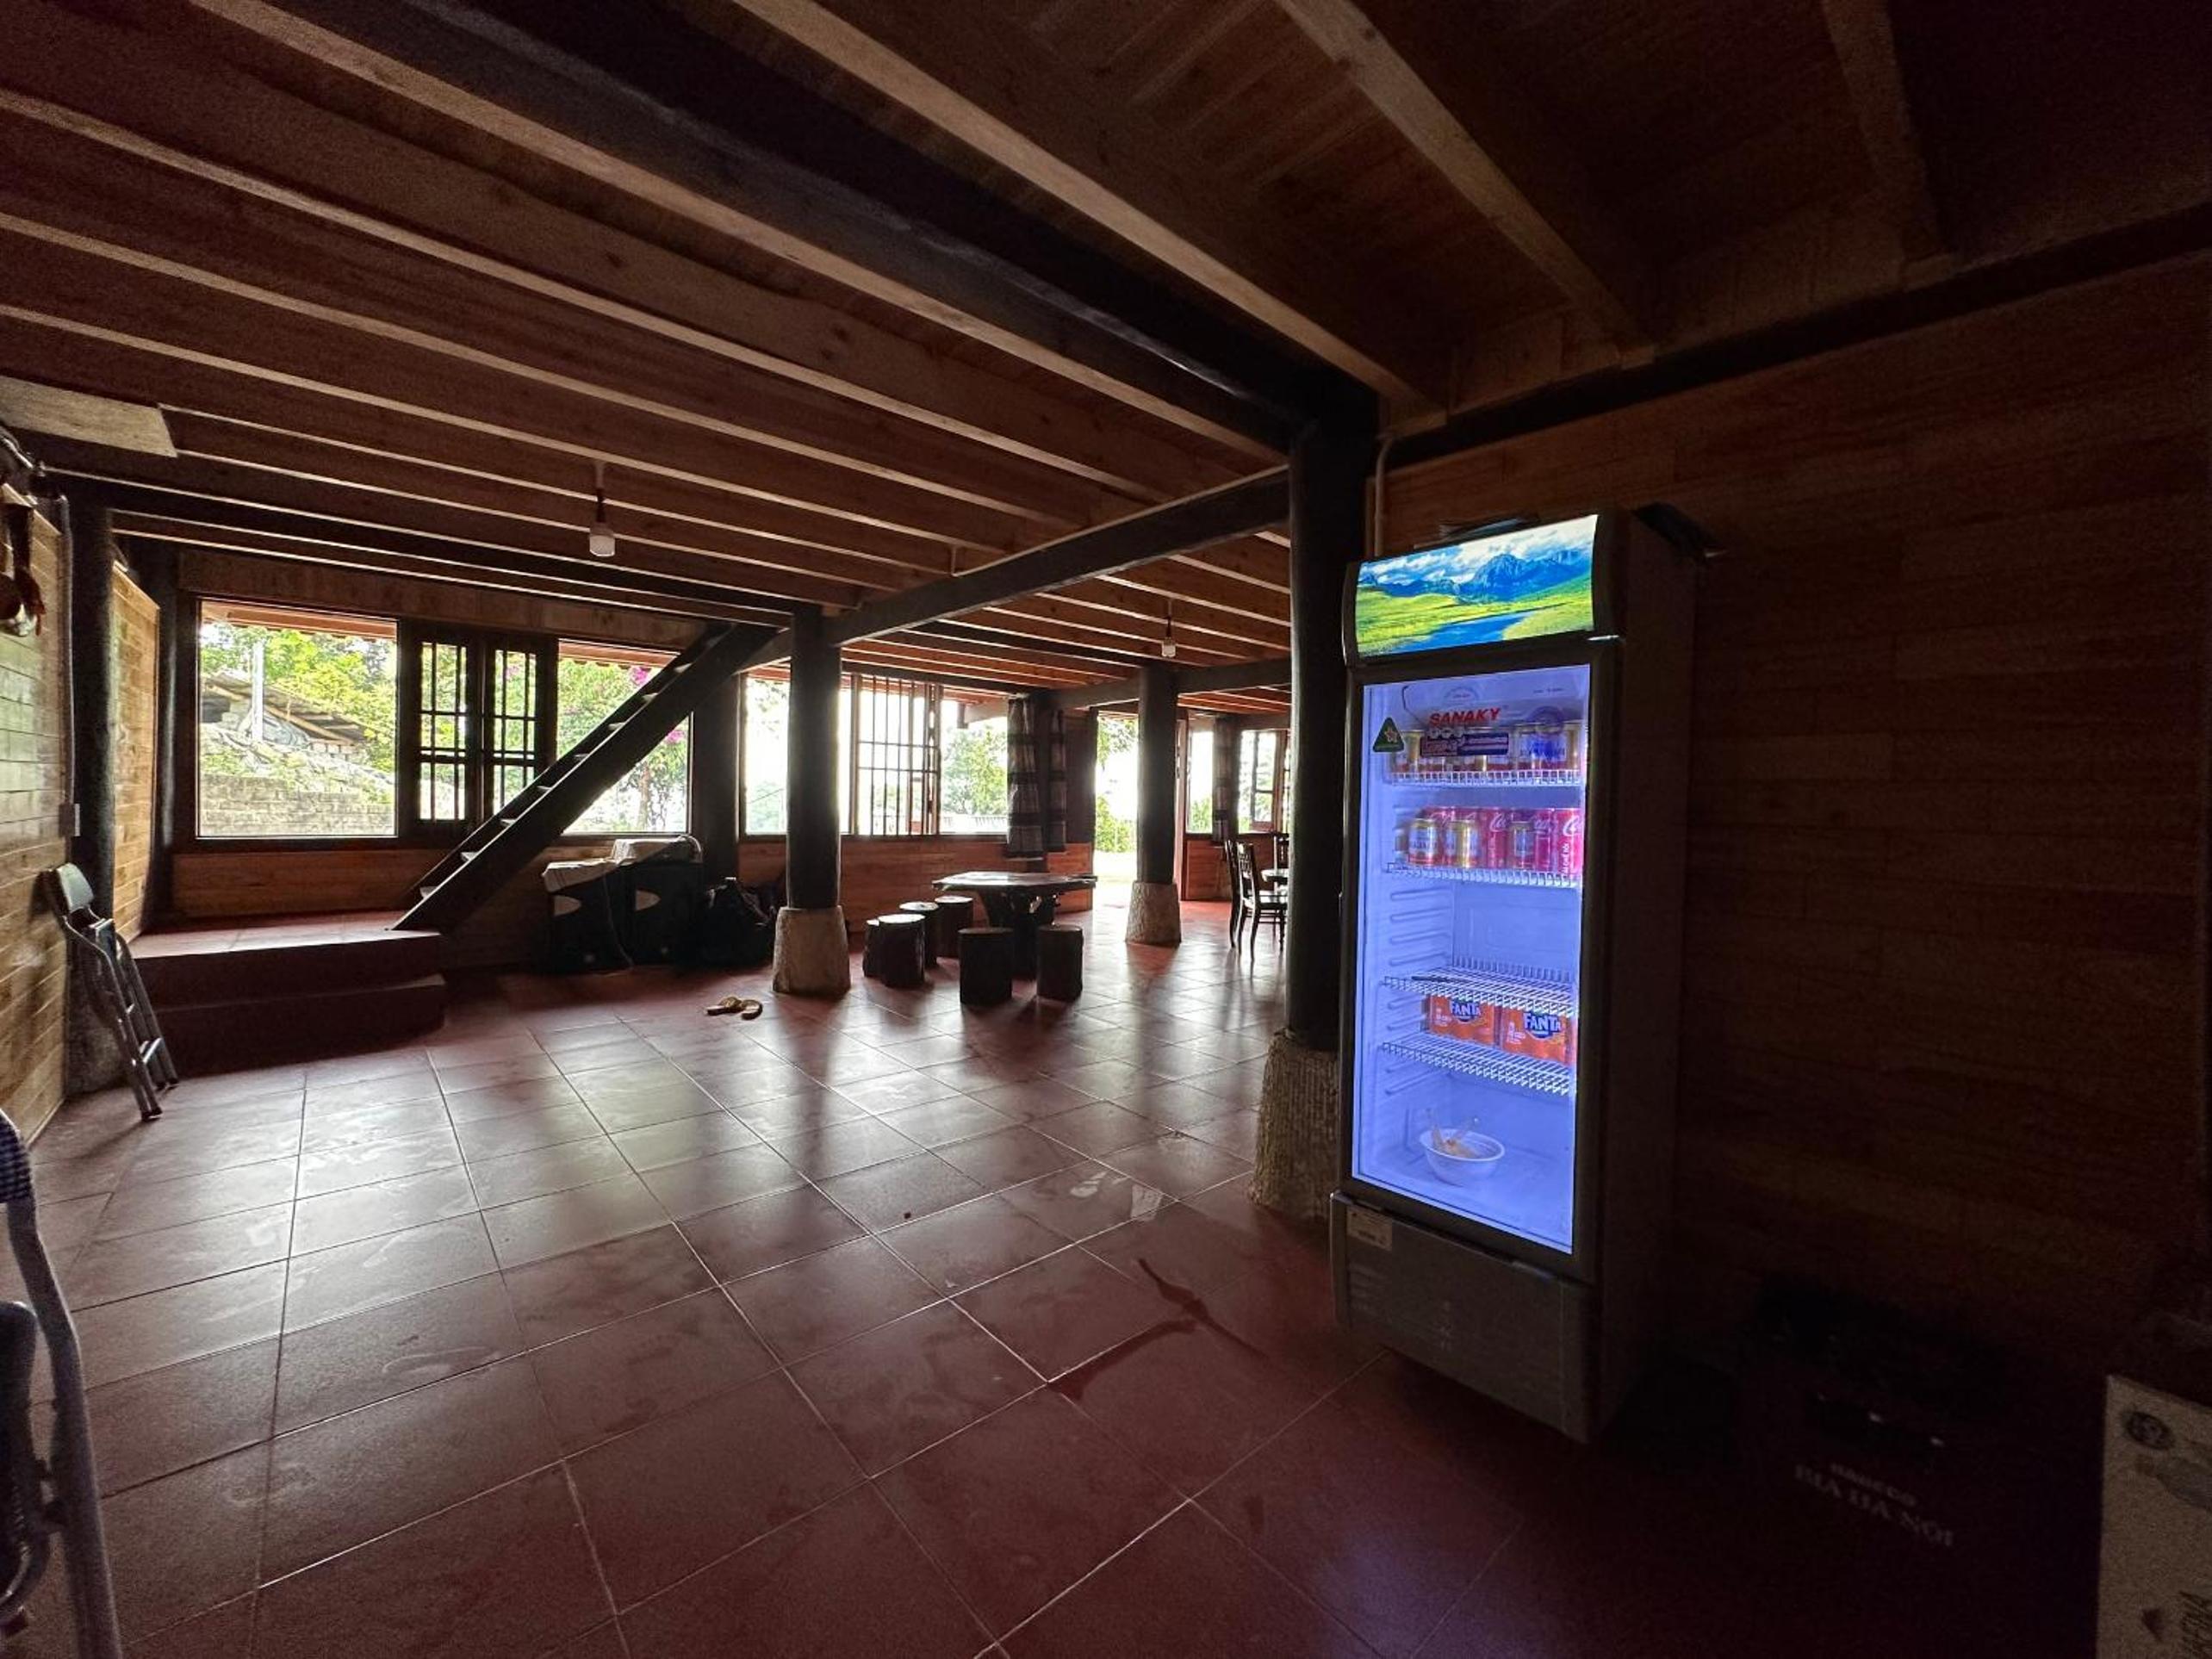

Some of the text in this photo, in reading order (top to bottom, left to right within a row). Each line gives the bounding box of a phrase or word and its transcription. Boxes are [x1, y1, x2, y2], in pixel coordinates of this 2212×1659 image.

[1428, 707, 1501, 727] SANAKY
[1451, 1000, 1482, 1017] FANTA
[1524, 1011, 1562, 1031] FANTA
